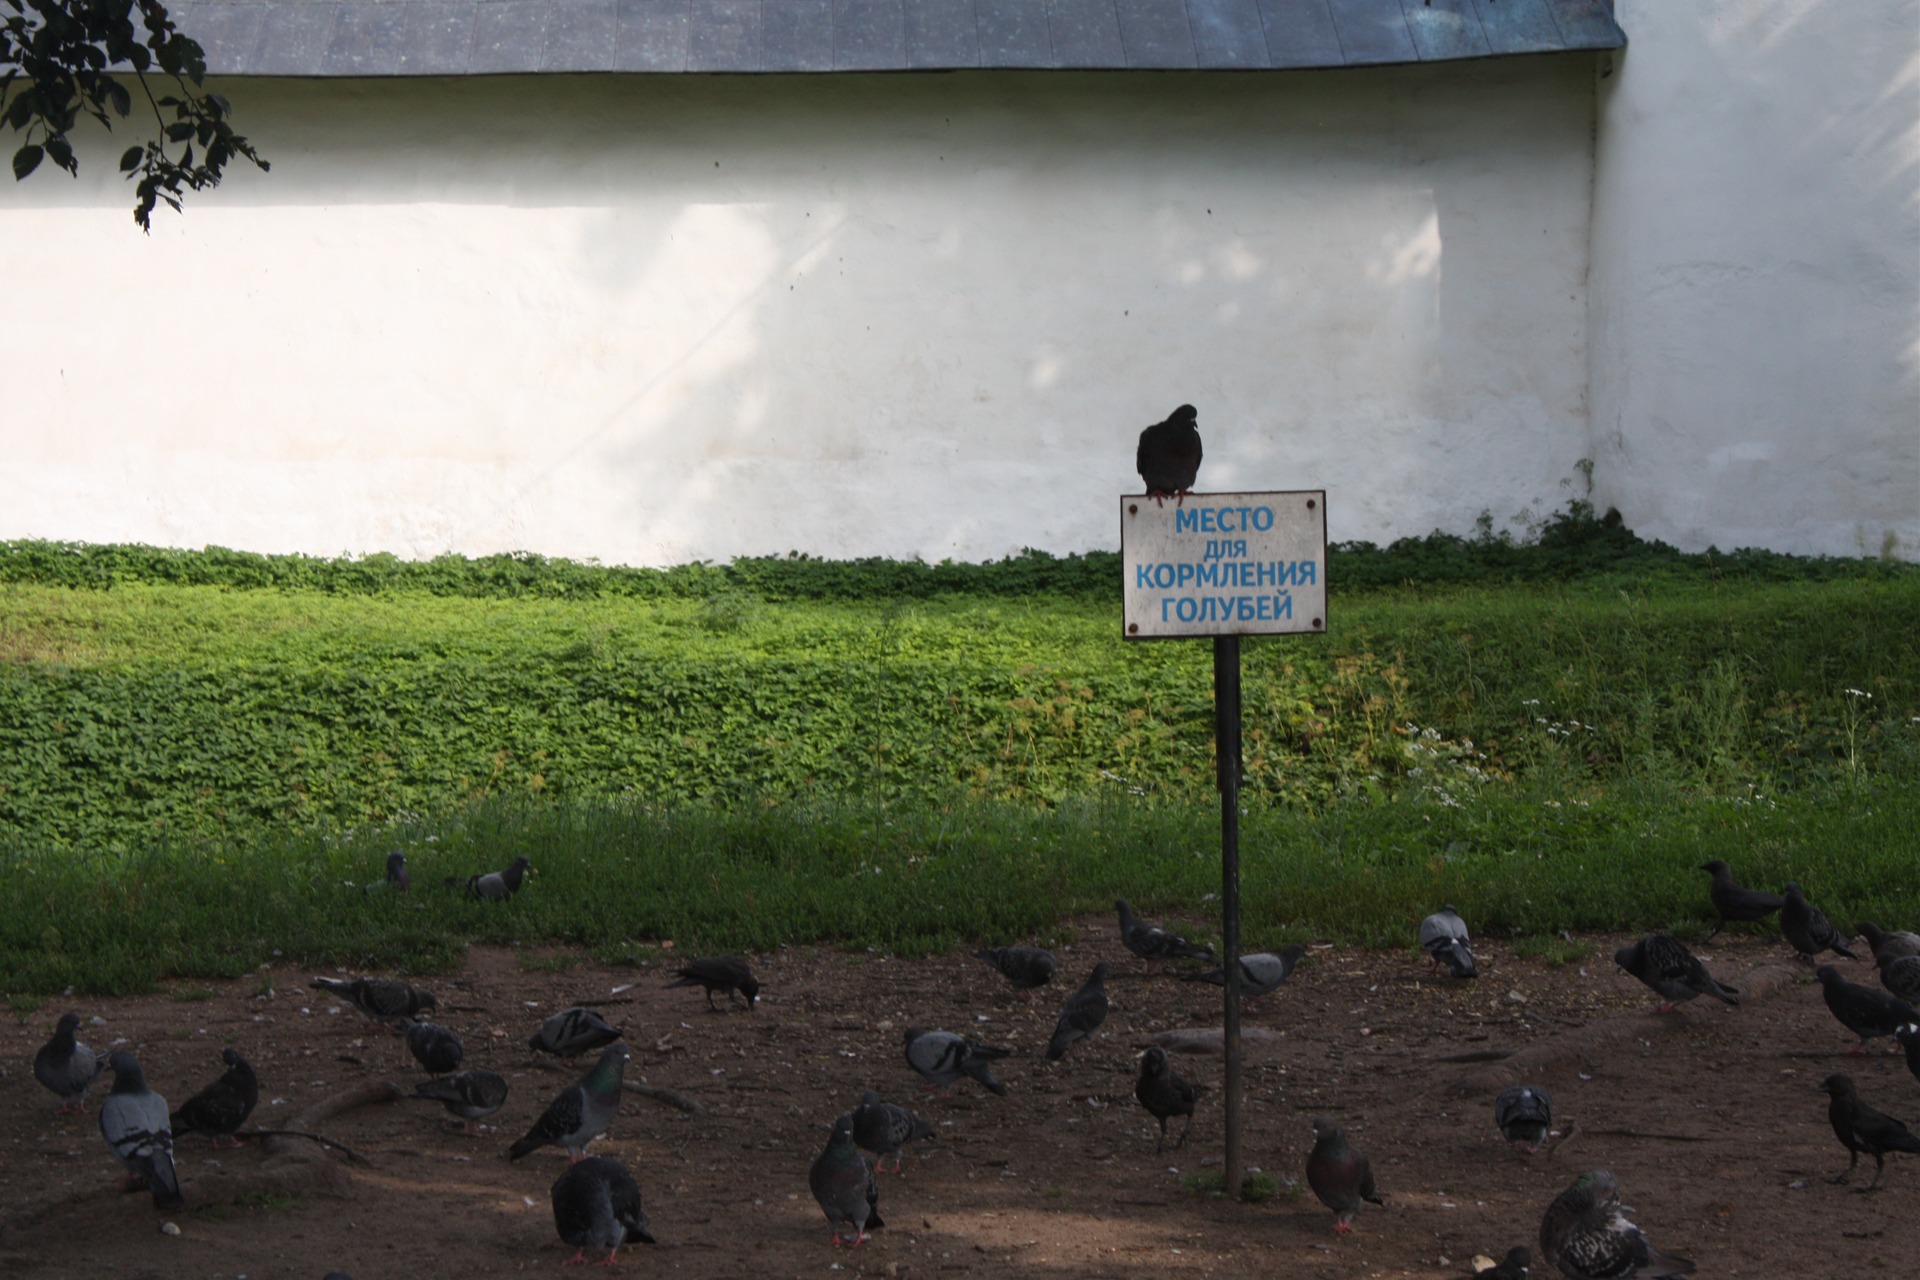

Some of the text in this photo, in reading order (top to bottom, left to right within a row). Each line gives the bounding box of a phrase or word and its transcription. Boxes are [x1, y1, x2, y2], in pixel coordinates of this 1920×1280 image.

[1176, 506, 1274, 533] МЕСТО
[1203, 539, 1247, 561] ДЛЯ
[1137, 561, 1316, 588] КОРМЛЕНИЯ
[1162, 590, 1292, 622] ГОЛУБЕЙ
